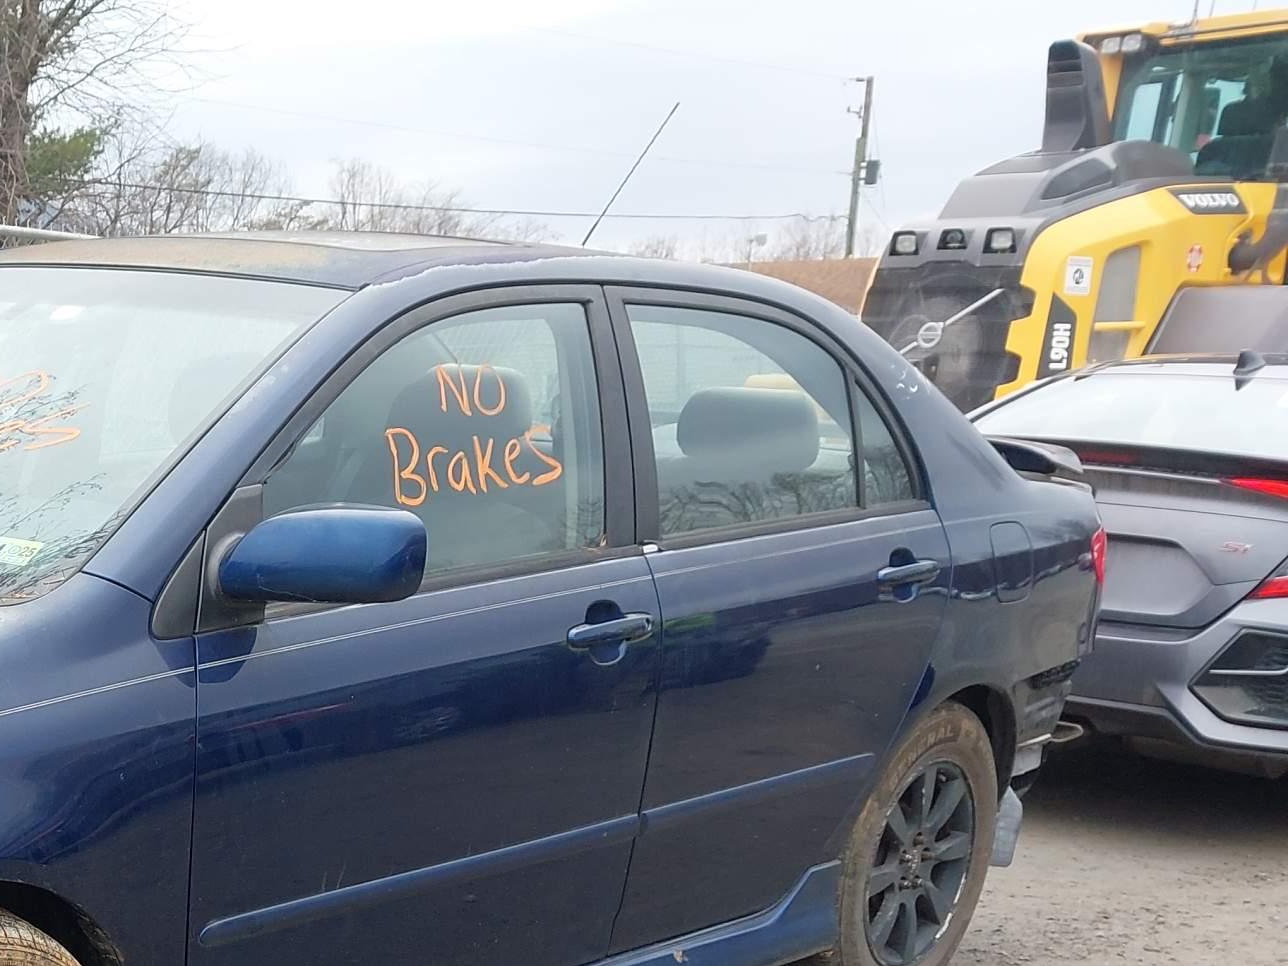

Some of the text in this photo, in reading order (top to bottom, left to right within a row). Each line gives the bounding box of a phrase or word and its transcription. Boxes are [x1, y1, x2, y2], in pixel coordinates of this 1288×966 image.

[1177, 192, 1240, 209] VOLVO
[1048, 322, 1072, 370] L90H
[435, 363, 506, 416] NO
